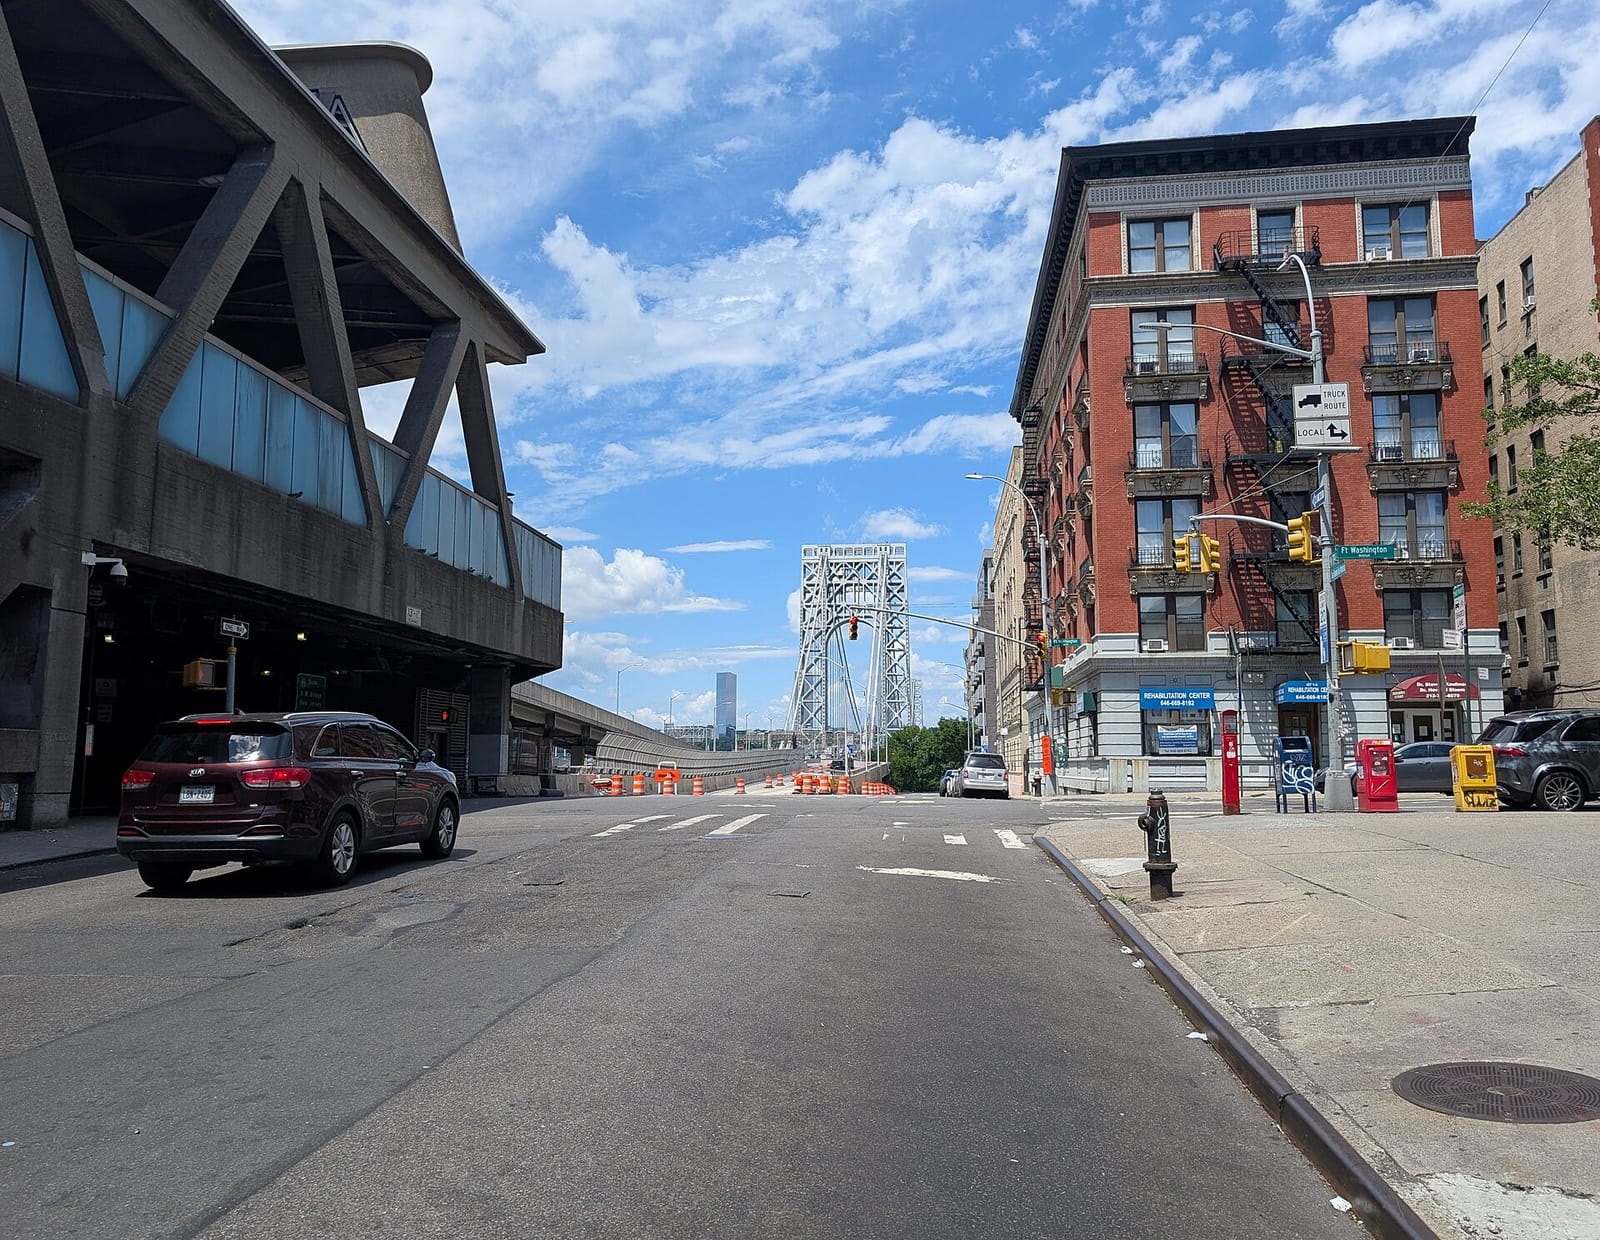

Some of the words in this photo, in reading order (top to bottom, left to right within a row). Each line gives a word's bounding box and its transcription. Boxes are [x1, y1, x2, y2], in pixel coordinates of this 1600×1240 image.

[1323, 390, 1346, 398] TRUCK
[1323, 402, 1347, 410] ROUTE
[1297, 428, 1325, 437] LOCAL
[1341, 546, 1348, 554] Ft
[1350, 546, 1388, 555] Washington
